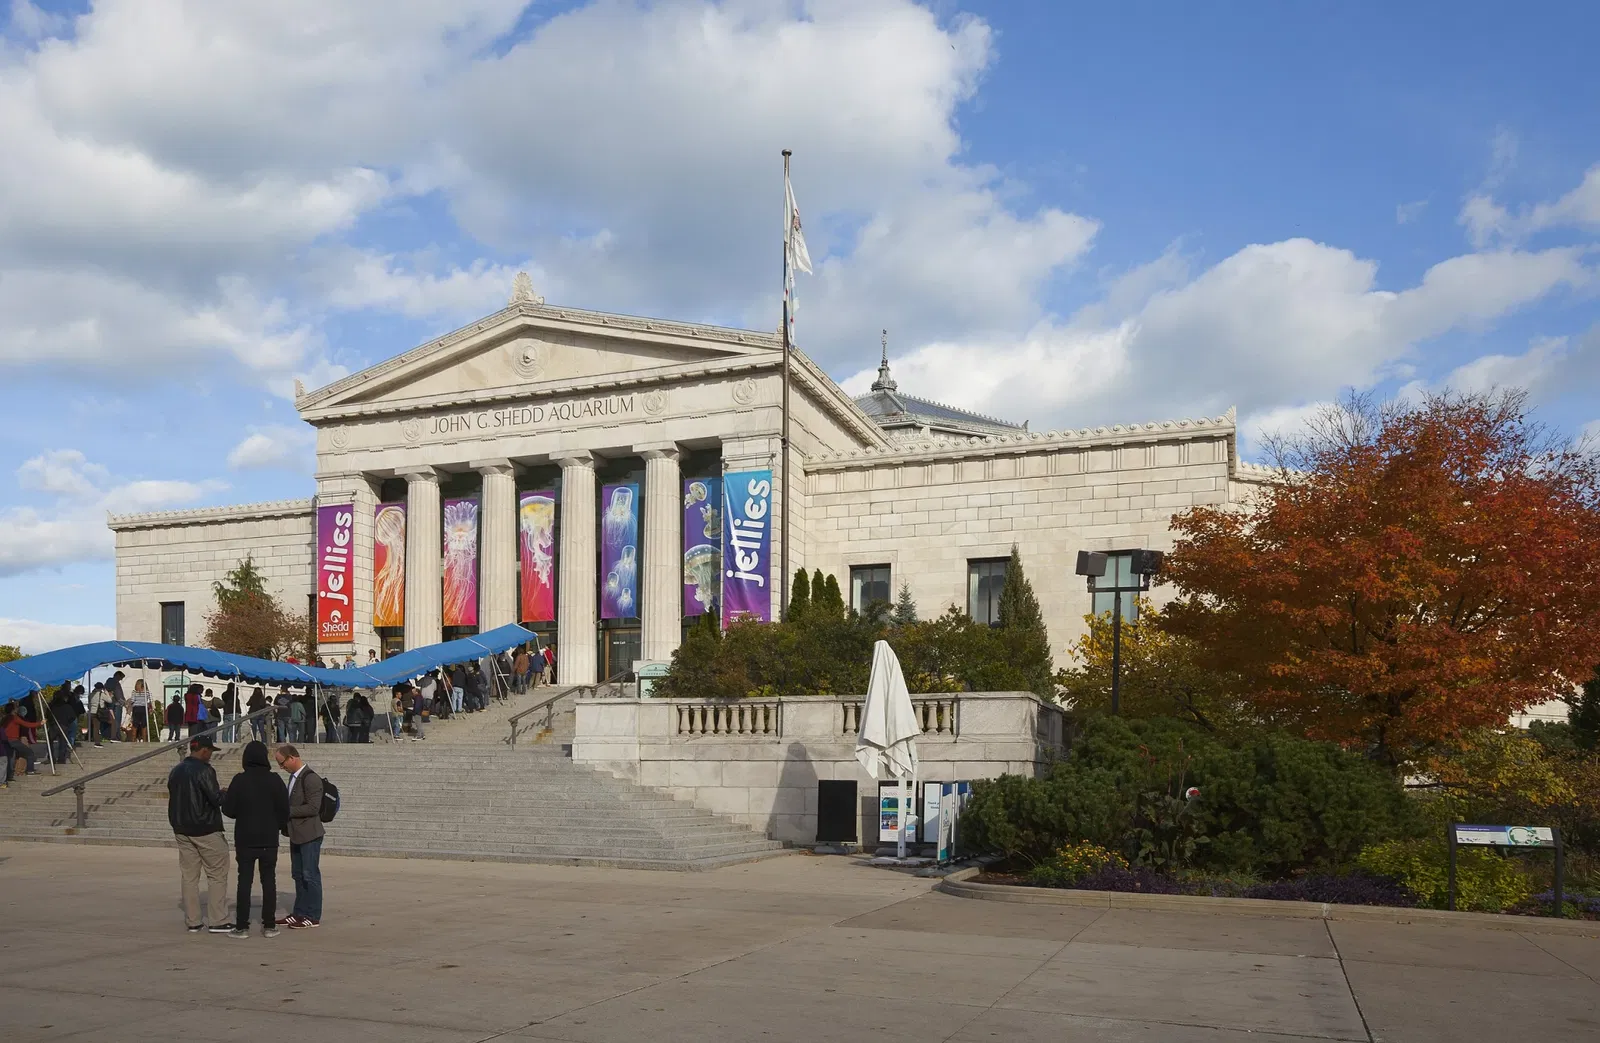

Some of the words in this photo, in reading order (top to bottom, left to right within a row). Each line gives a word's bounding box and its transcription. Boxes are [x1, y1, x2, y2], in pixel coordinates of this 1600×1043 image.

[430, 415, 471, 435] JOHN
[477, 413, 491, 429] G.
[493, 407, 544, 428] SHEDD
[548, 396, 634, 421] AQUARIUM
[320, 511, 352, 606] jellies
[726, 478, 770, 587] jellies
[322, 620, 349, 633] Shedd
